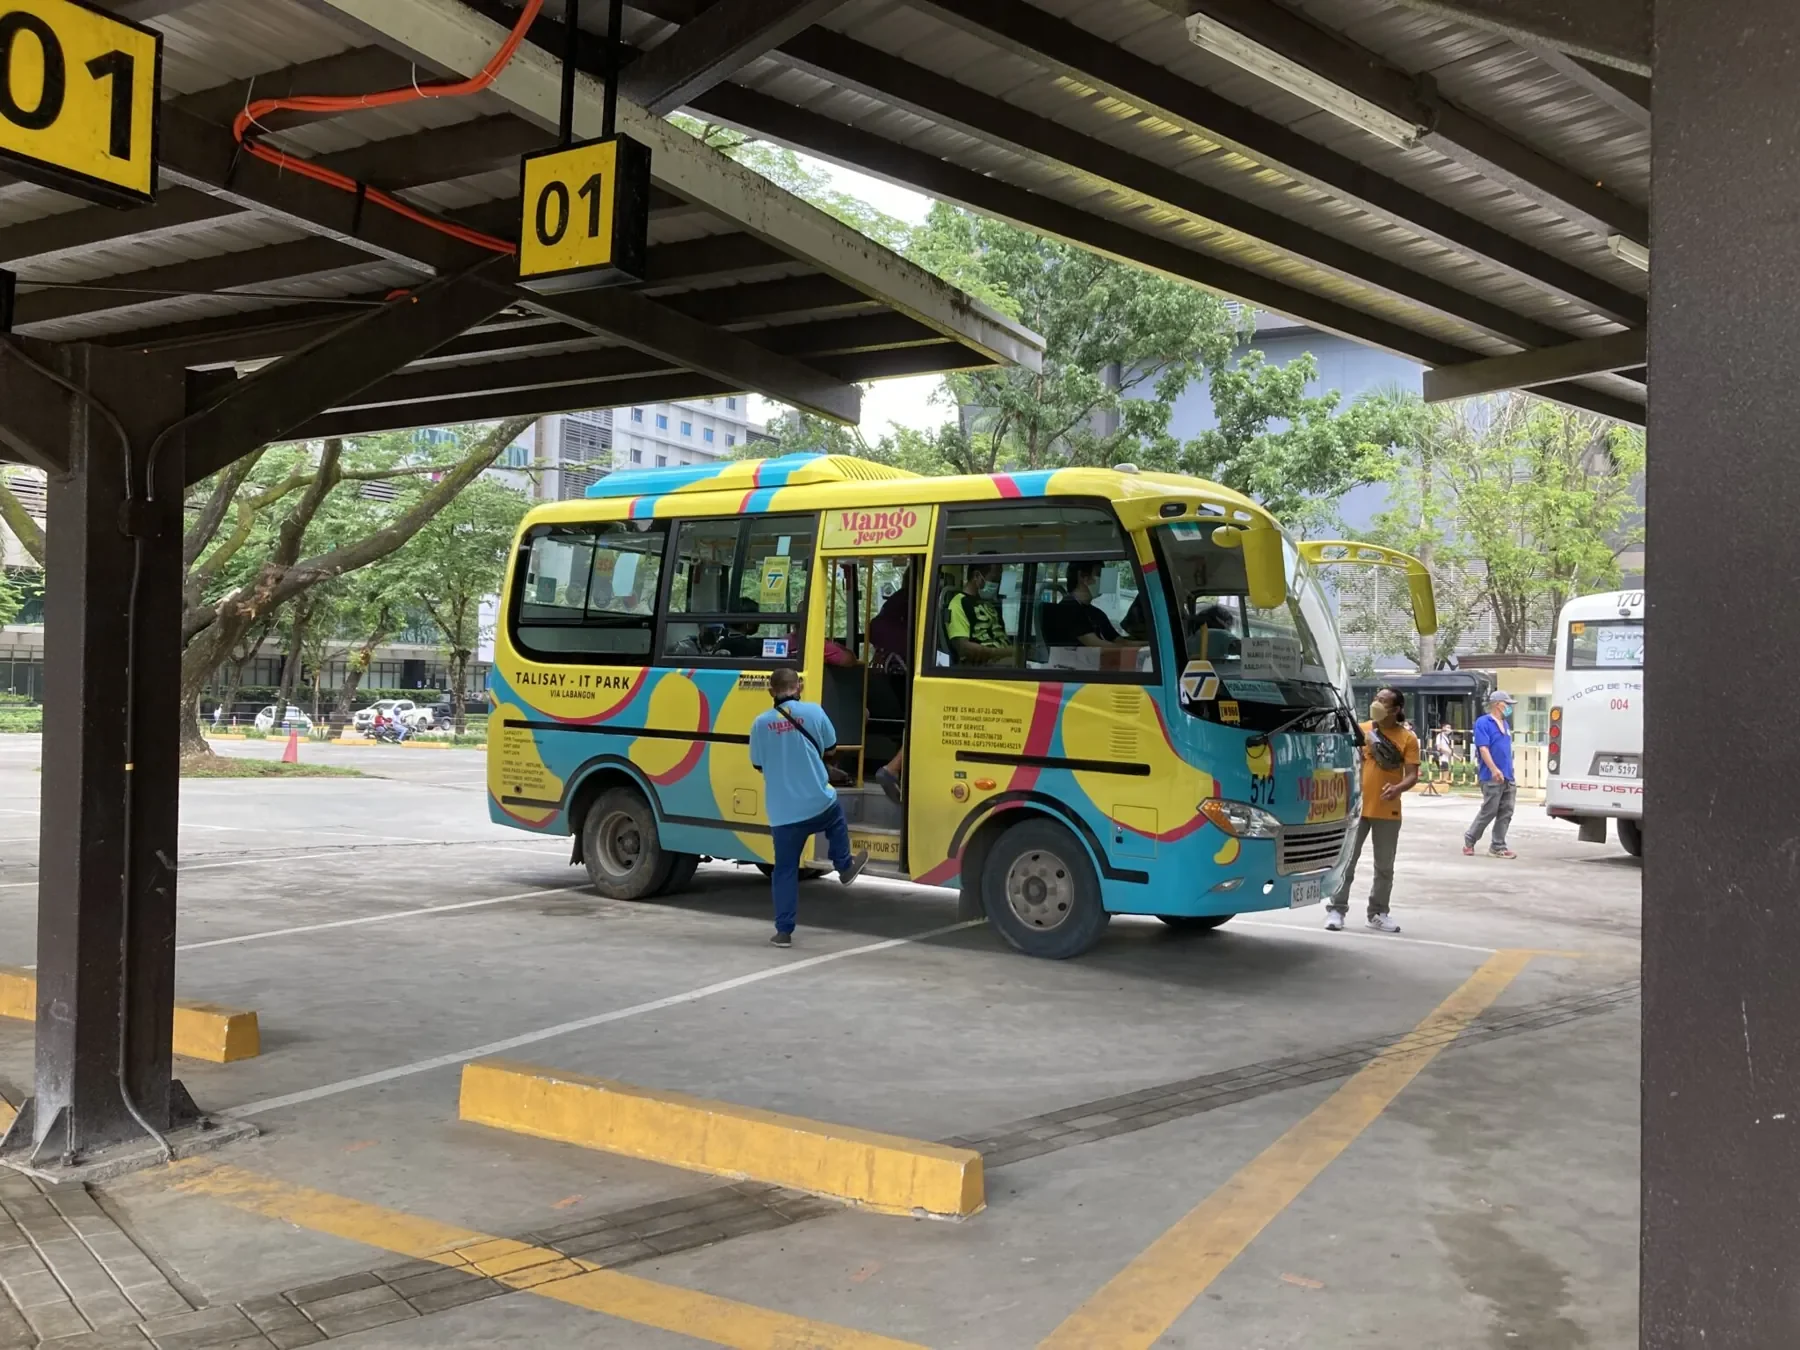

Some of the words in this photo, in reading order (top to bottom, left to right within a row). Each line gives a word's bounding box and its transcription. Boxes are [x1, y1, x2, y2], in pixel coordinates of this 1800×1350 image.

[0, 11, 135, 161] 01
[535, 172, 602, 247] 01
[838, 507, 917, 540] Mango
[853, 530, 886, 545] Jeep
[516, 672, 566, 686] TALISAY
[579, 674, 591, 688] IT
[595, 675, 630, 690] PARK
[1585, 683, 1604, 695] GOD
[1607, 682, 1621, 690] BE
[1624, 682, 1642, 691] THE
[550, 689, 561, 698] VIA
[562, 690, 596, 700] LABANGON
[1610, 698, 1629, 711] 004
[1600, 763, 1614, 774] NGP
[1250, 774, 1276, 805] 512
[1297, 774, 1344, 813] Mango
[1560, 782, 1598, 792] KEEP
[1603, 784, 1644, 795] DISTA
[852, 840, 872, 850] WATCH
[873, 841, 889, 853] YOUR
